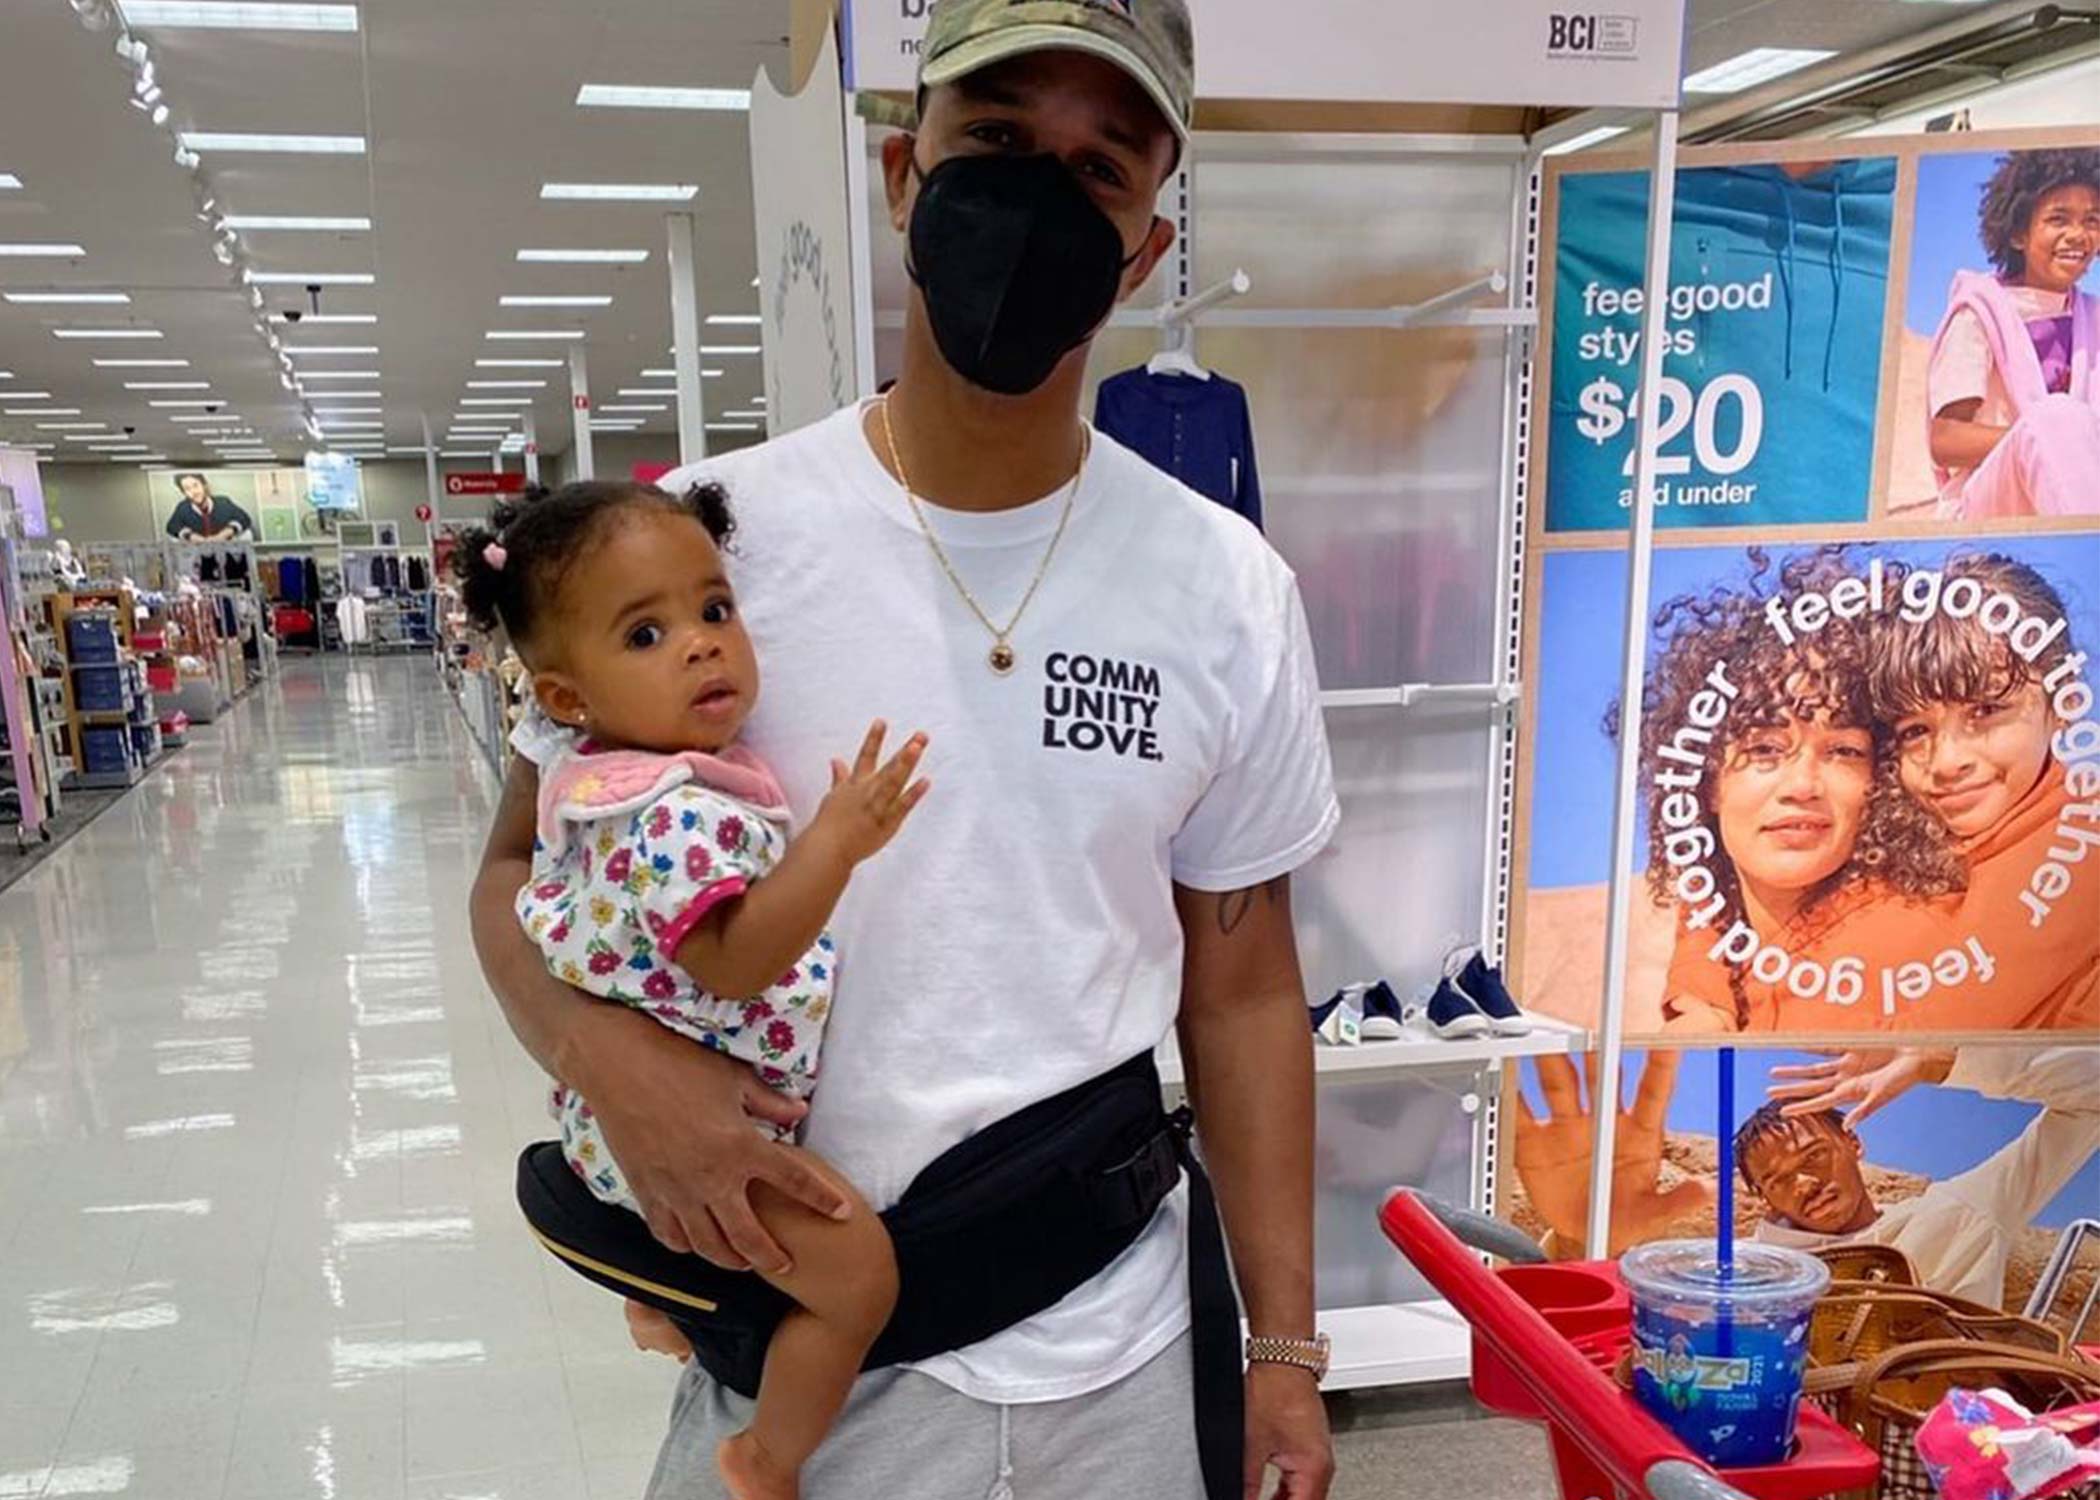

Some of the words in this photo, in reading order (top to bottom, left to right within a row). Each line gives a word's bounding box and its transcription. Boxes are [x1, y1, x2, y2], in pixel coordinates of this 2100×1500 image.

[901, 0, 934, 18] b
[1549, 15, 1595, 50] BCI
[1583, 273, 1772, 320] feegood
[1579, 326, 1695, 365] stys
[1577, 374, 1763, 475] $20
[1618, 482, 1669, 507] ad
[1677, 479, 1757, 504] under
[1045, 652, 1159, 697] COMM
[1044, 685, 1159, 728] UNITY
[1765, 559, 1883, 645] feel
[1900, 569, 2068, 663] good
[2019, 650, 2100, 928] together
[1654, 660, 1740, 931] together
[1706, 921, 1866, 1006] good
[1881, 936, 1996, 1015] feel
